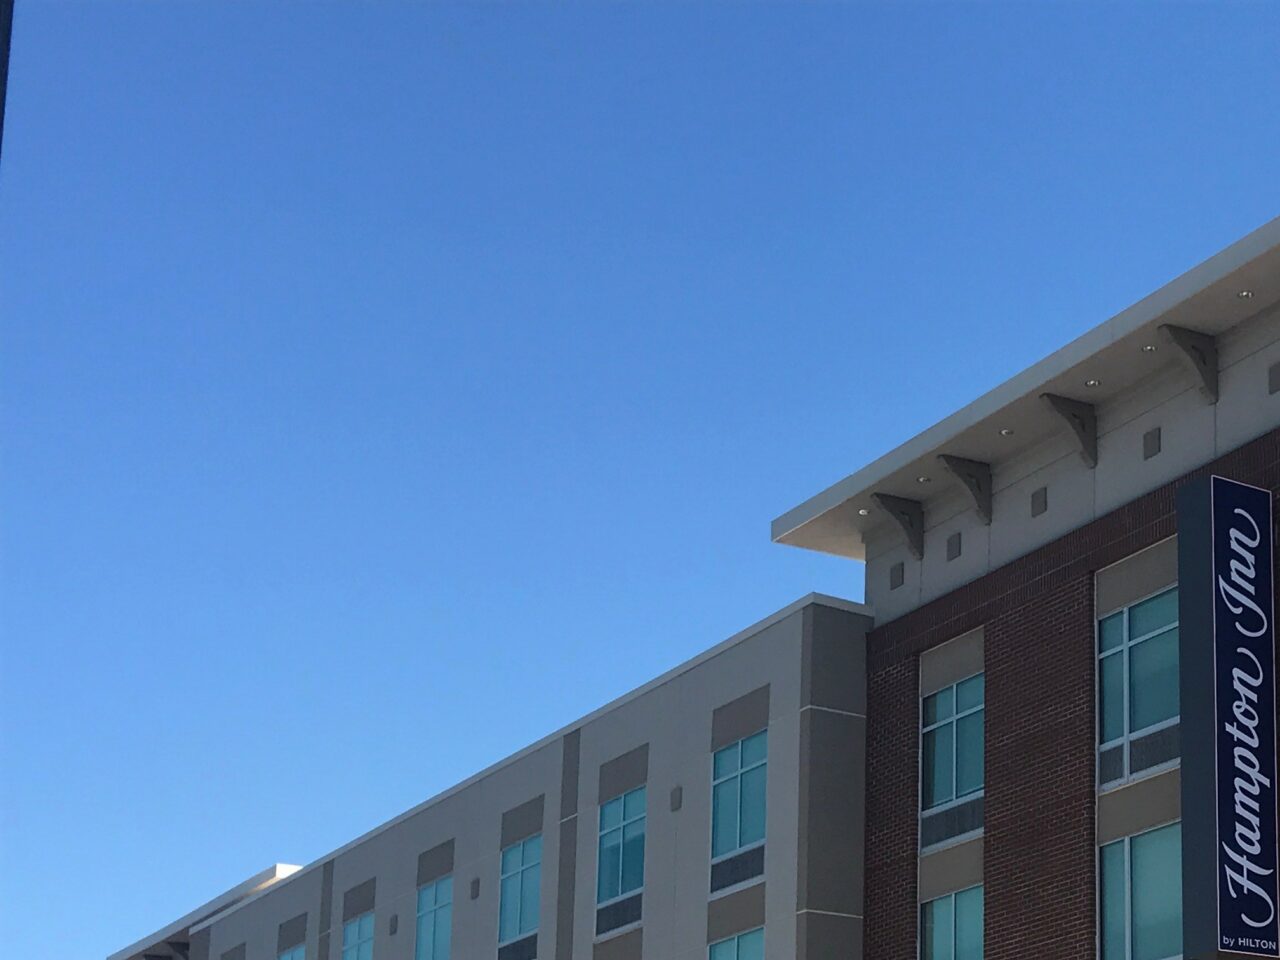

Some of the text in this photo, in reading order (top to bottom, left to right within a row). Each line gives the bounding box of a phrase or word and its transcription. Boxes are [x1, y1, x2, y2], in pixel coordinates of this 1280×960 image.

[1218, 508, 1274, 928] Hampton Inn
[1222, 935, 1277, 950] by HILTON
